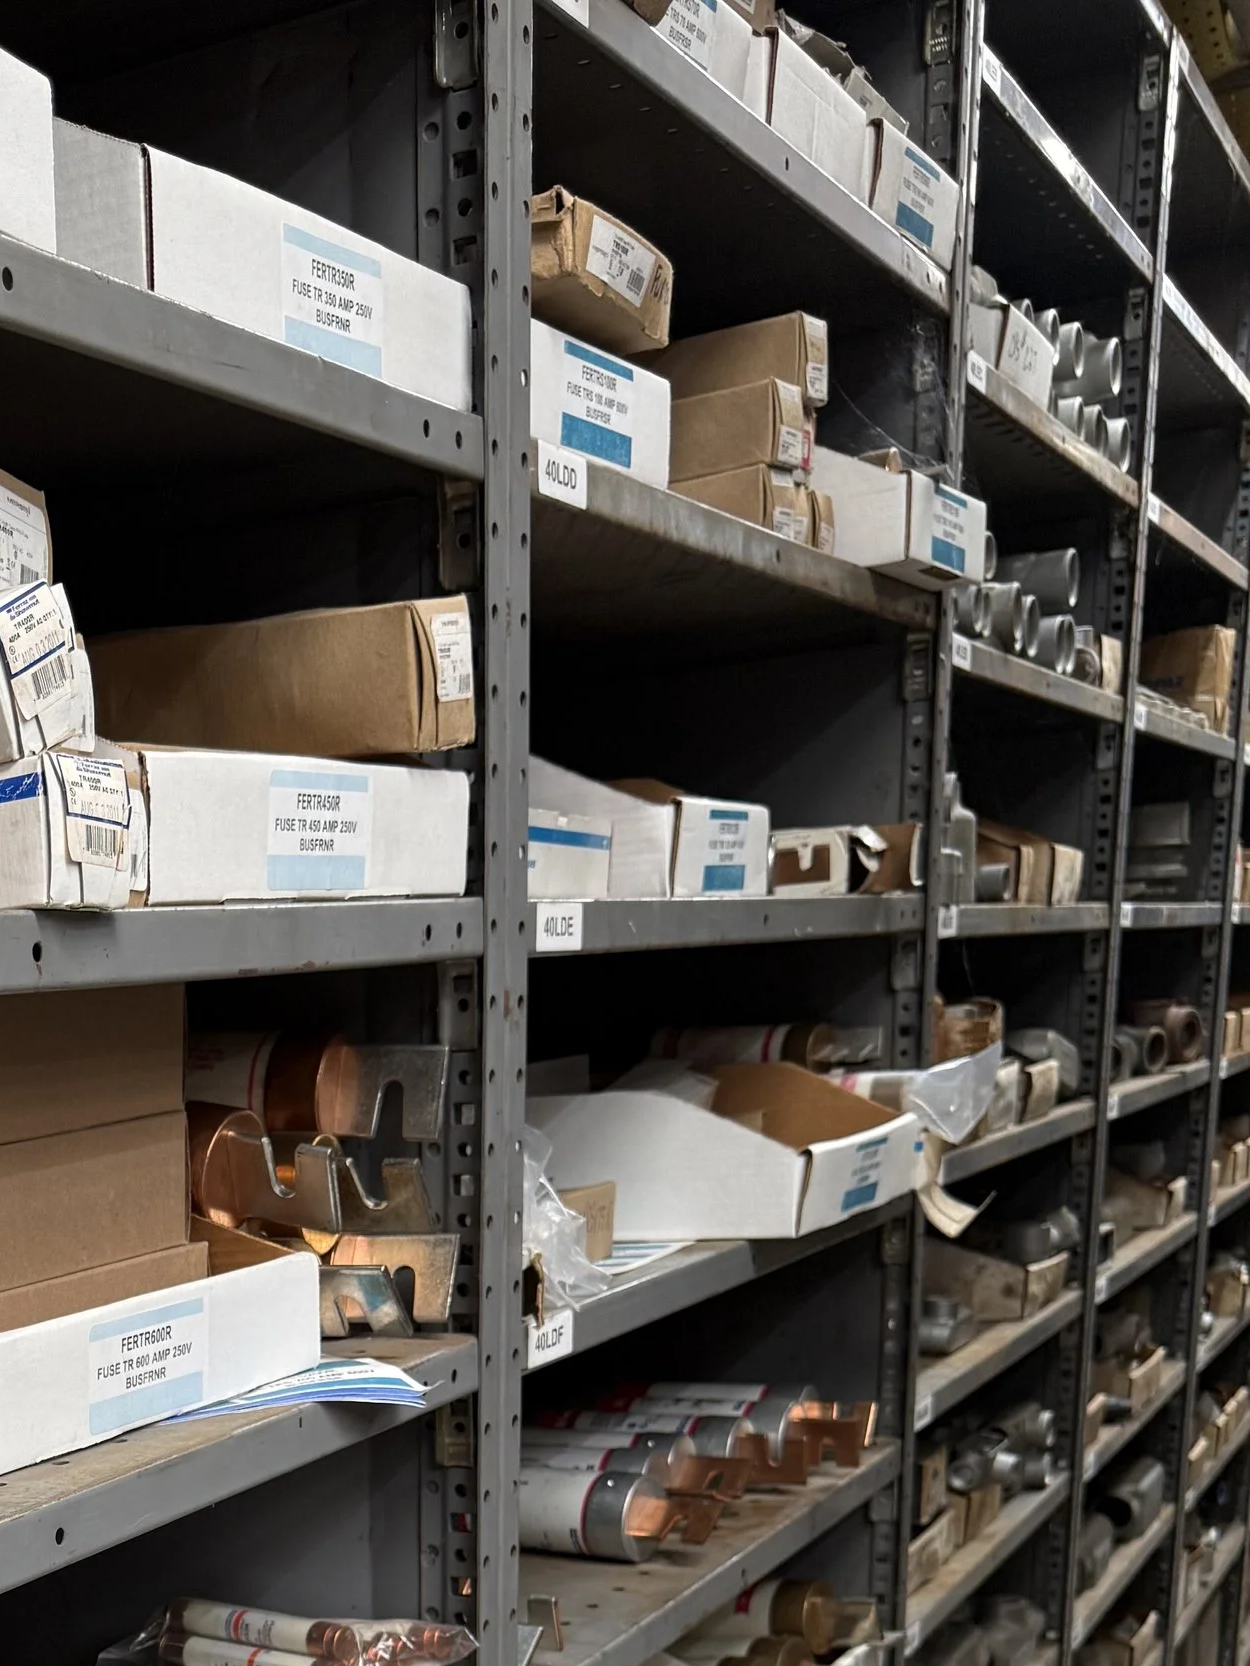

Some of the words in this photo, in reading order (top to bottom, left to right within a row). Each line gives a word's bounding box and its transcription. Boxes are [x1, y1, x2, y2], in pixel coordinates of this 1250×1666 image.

[686, 20, 696, 35] AMP
[311, 258, 355, 291] FERTR350R
[293, 278, 311, 299] FUSE
[314, 287, 323, 303] TR
[324, 291, 336, 308] 350
[337, 296, 354, 313] AMP
[355, 302, 372, 320] 250V
[316, 309, 351, 334] BUSFRNR
[567, 381, 582, 397] FUSE
[545, 459, 577, 490] 40LDD
[14, 614, 34, 631] TR400R
[21, 649, 36, 665] AUG
[297, 792, 340, 812] FERTR450R
[275, 818, 297, 832] FUSE
[298, 819, 307, 832] TR
[308, 820, 321, 832] 450
[322, 820, 339, 833] AMP
[339, 821, 357, 834] 250V
[299, 838, 335, 852] BUSFRNR
[544, 916, 573, 936] 40LDE
[121, 1325, 172, 1354] FERTR600R
[535, 1324, 564, 1354] 40LDF
[98, 1362, 120, 1380] FUSE
[123, 1359, 134, 1372] TR
[136, 1354, 150, 1368] 600
[152, 1348, 171, 1364] AMP
[172, 1342, 192, 1358] 250V
[126, 1367, 166, 1389] BUSFRNR
